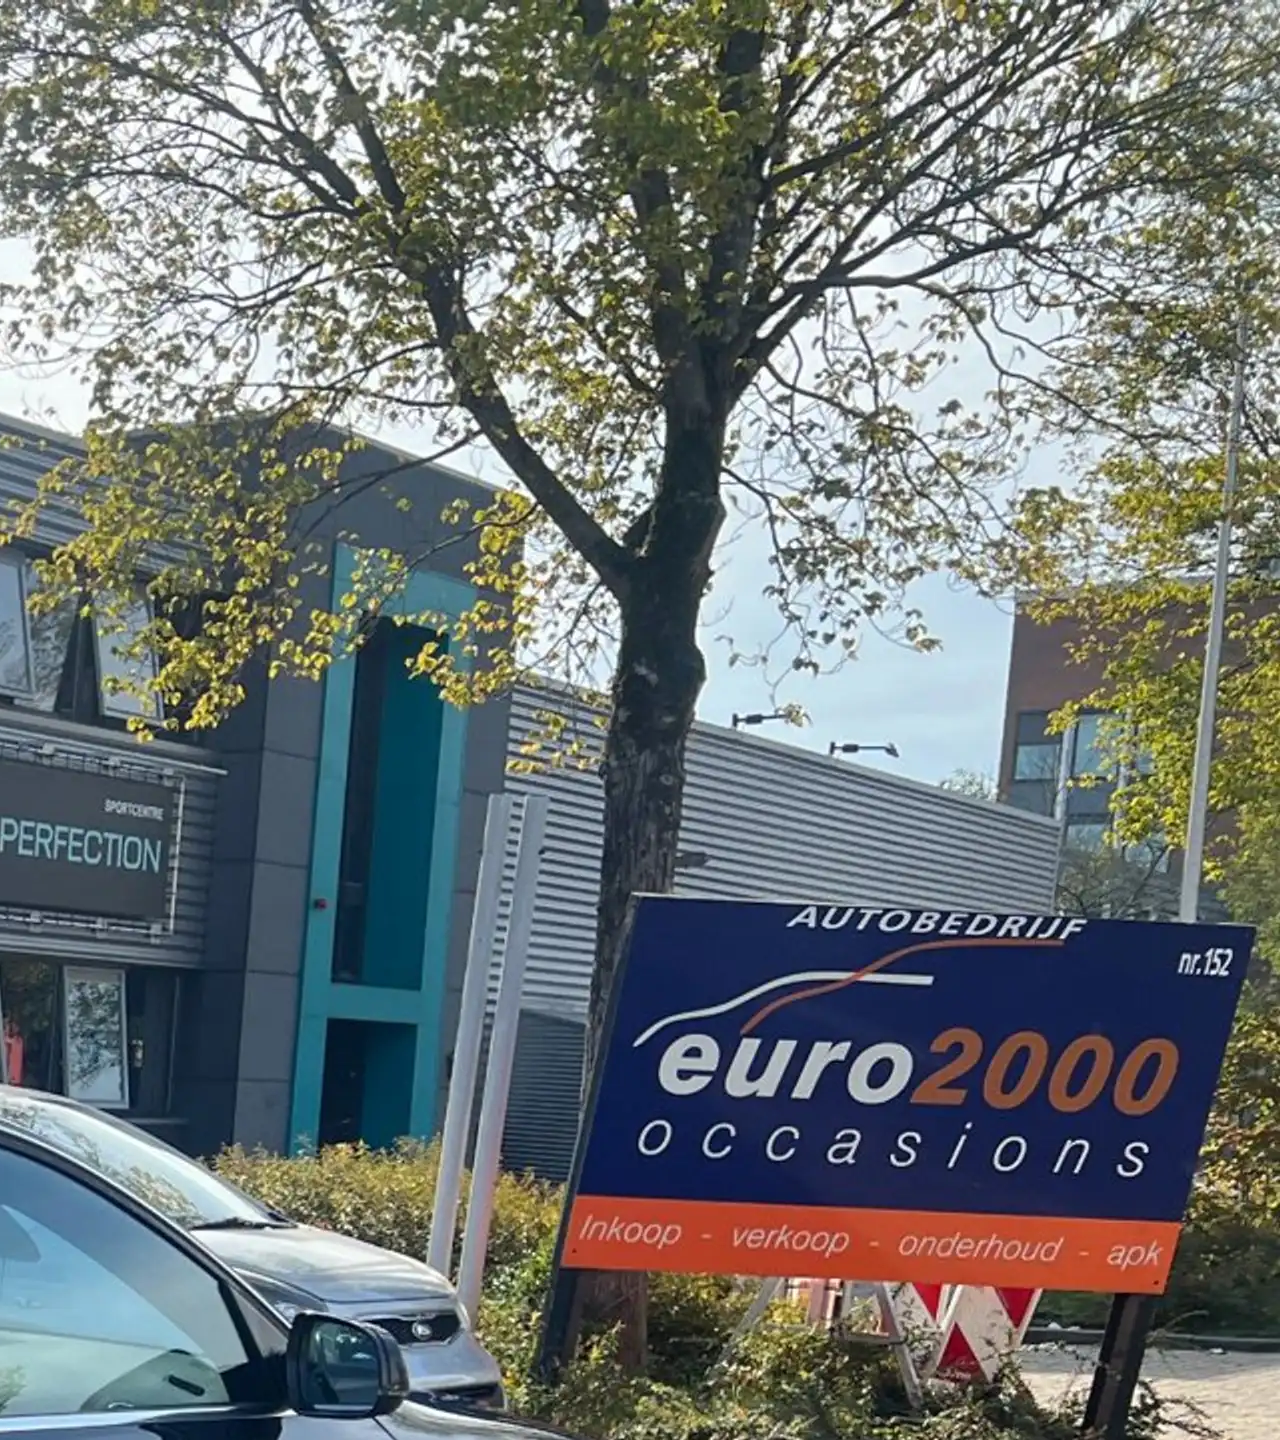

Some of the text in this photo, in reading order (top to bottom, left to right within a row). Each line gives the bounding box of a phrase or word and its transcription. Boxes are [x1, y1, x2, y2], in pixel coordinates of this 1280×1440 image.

[0, 818, 162, 873] PERFECTION
[786, 905, 1087, 941] AUTOBEDRIJF
[1178, 948, 1233, 977] nr.152
[657, 1026, 1180, 1116] euro2000
[637, 1119, 1150, 1178] occasions
[578, 1214, 683, 1247] Inkoop
[732, 1228, 850, 1258] verkoop
[898, 1232, 1064, 1264] onderhoud
[1106, 1241, 1165, 1270] apk
